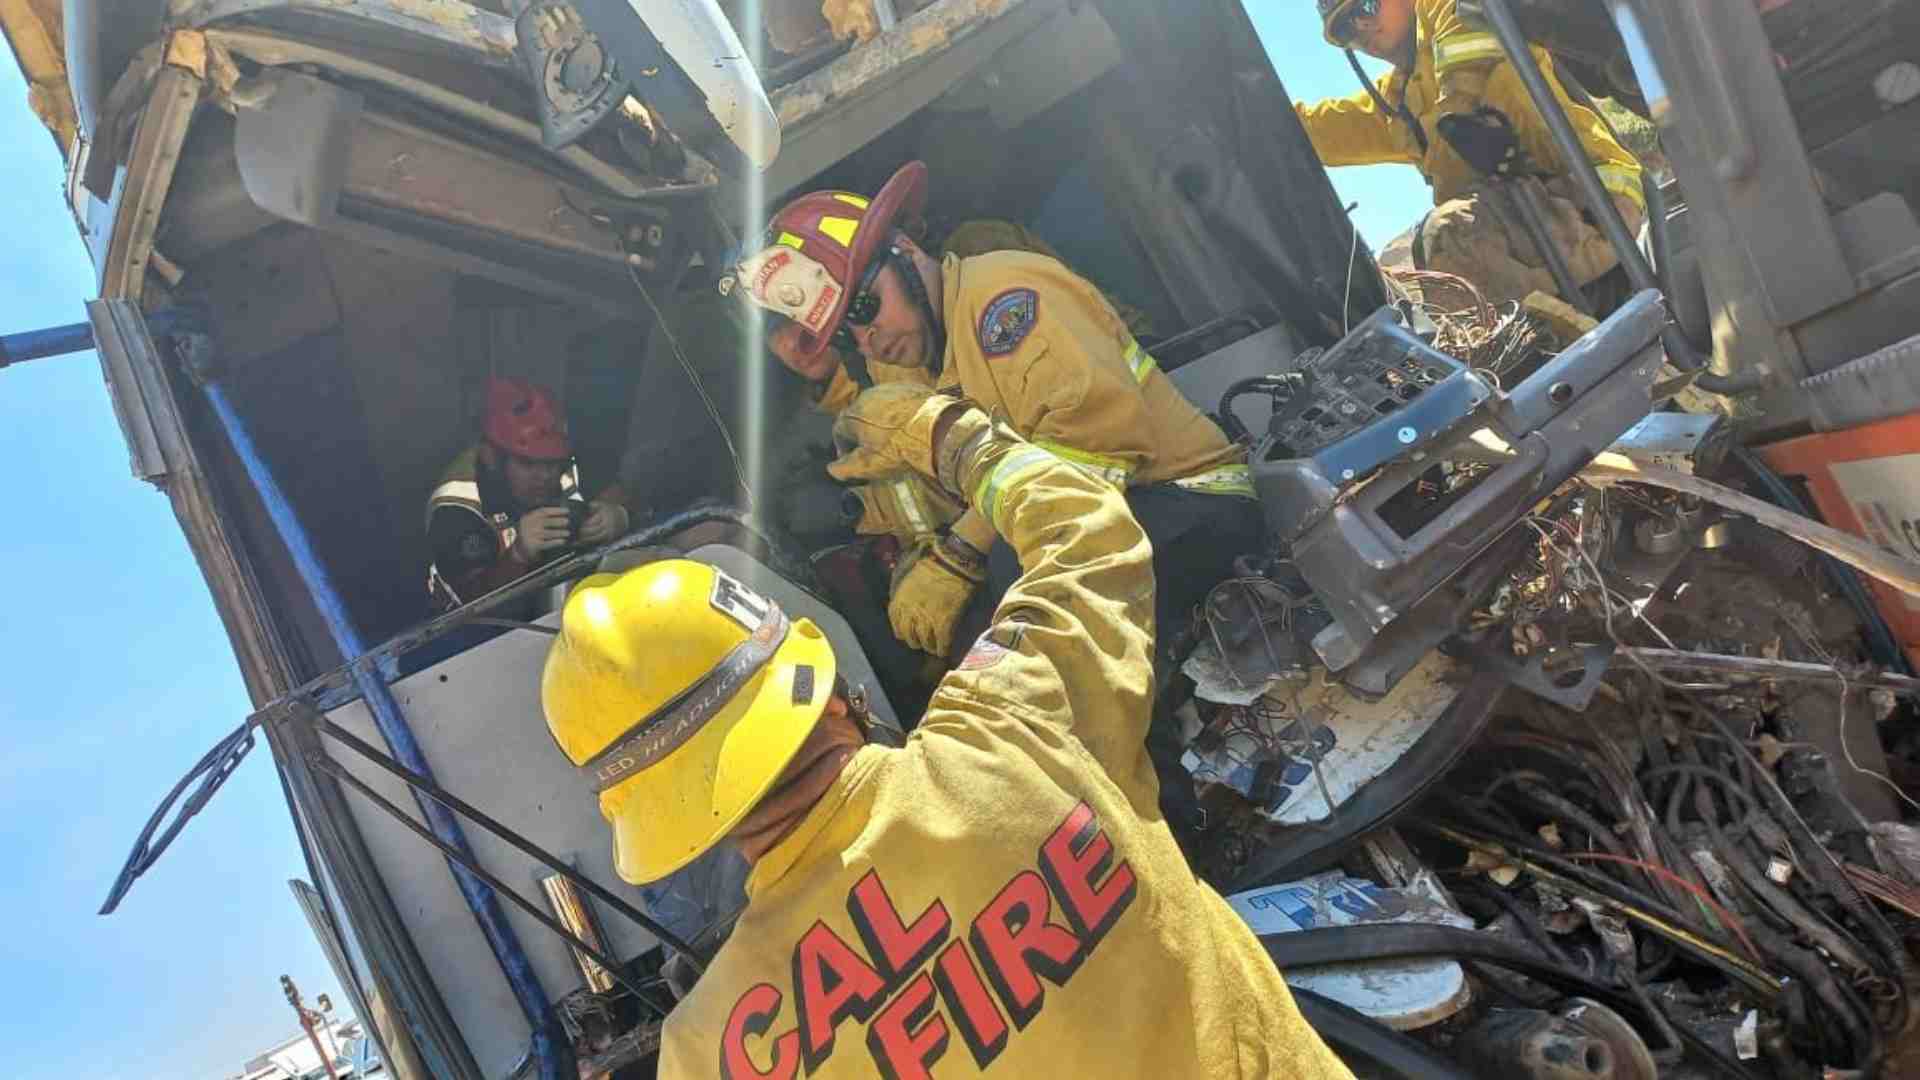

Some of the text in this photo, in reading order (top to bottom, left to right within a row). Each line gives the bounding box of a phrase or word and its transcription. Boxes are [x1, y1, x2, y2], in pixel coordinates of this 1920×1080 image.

[597, 756, 635, 781] LED
[719, 866, 952, 1080] CAL
[865, 800, 1138, 1080] FIRE
